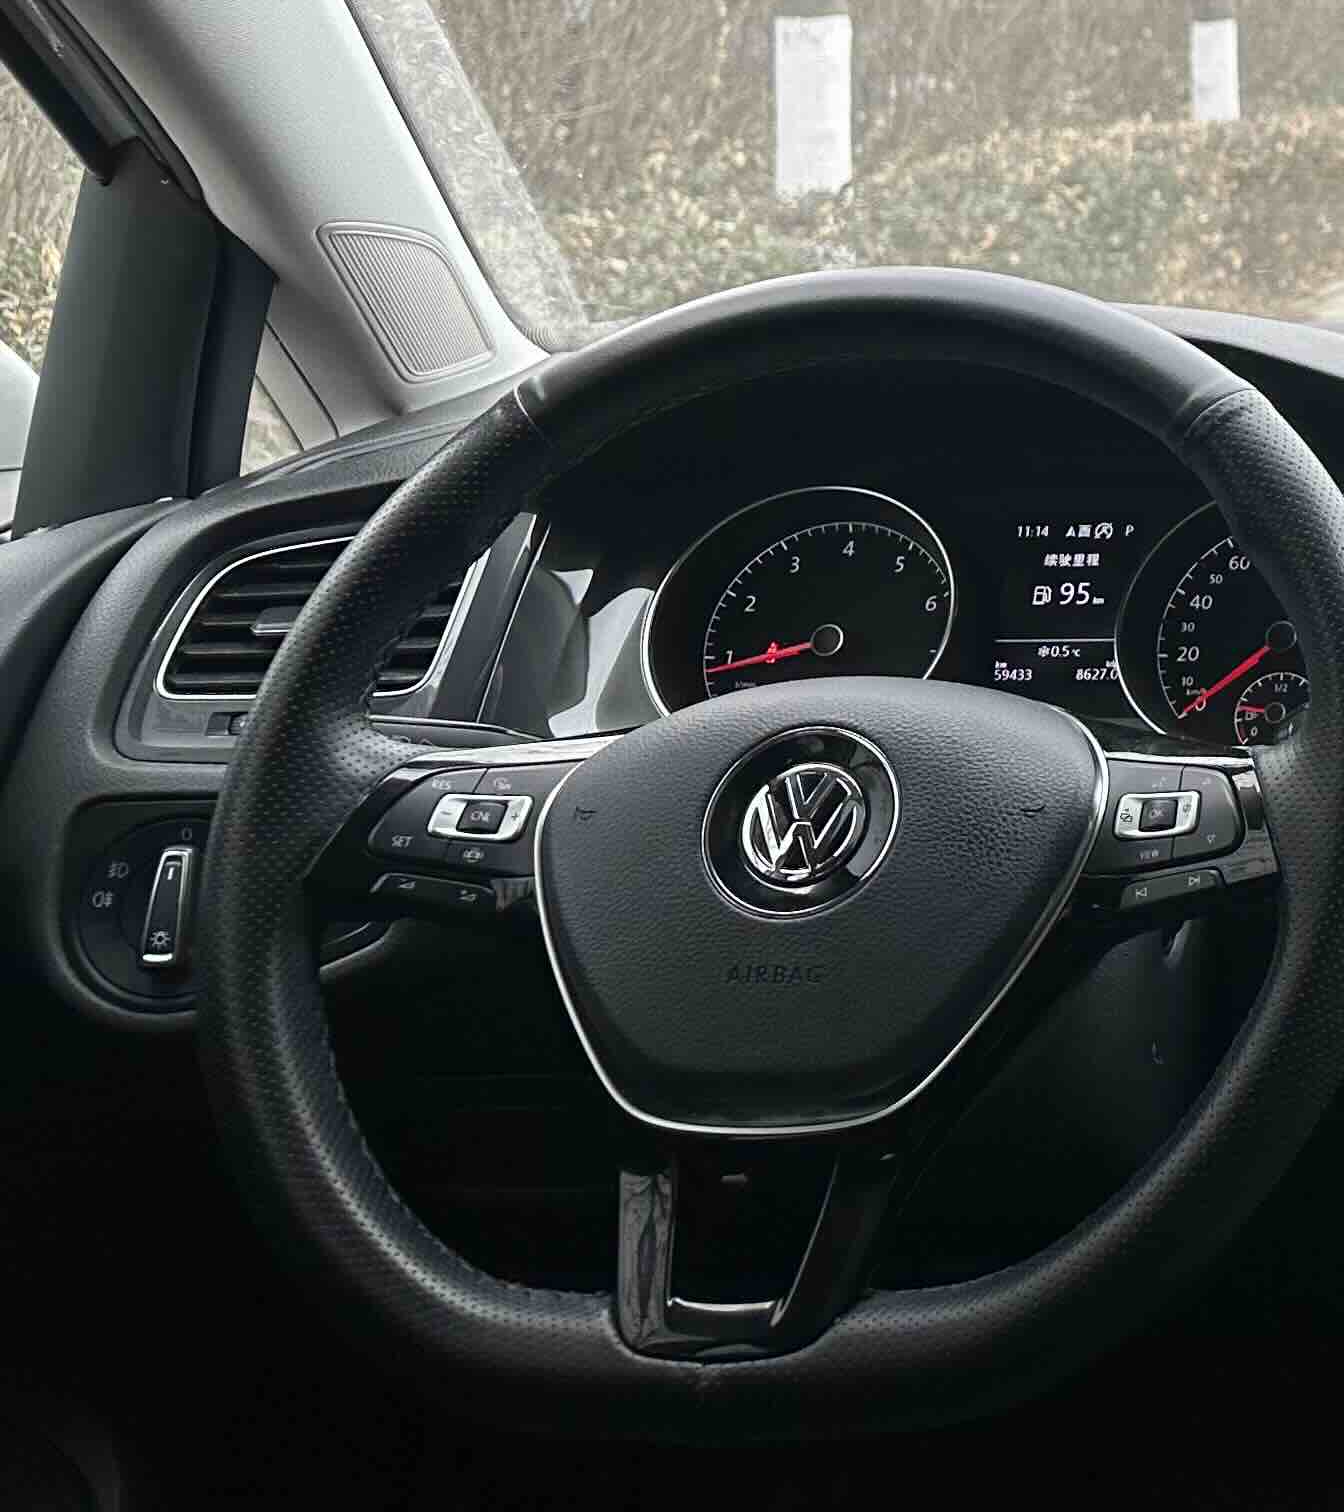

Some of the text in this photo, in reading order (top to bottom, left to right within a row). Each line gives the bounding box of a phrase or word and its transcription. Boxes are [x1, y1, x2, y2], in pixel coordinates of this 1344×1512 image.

[1017, 524, 1135, 538] 11:14 P
[842, 540, 855, 557] 4
[789, 555, 801, 574] 3
[894, 555, 905, 573] 5
[1228, 555, 1251, 571] 60
[1209, 573, 1224, 585] 50
[744, 595, 757, 612] 2
[924, 595, 937, 612] 6
[1189, 594, 1213, 610] 40
[1181, 621, 1196, 633] 30
[723, 648, 735, 666] 1
[1176, 646, 1200, 662] 20
[994, 666, 1033, 681] 59433
[1181, 675, 1194, 687] 10
[390, 834, 414, 850] SET
[725, 964, 825, 985] AIRBAG
